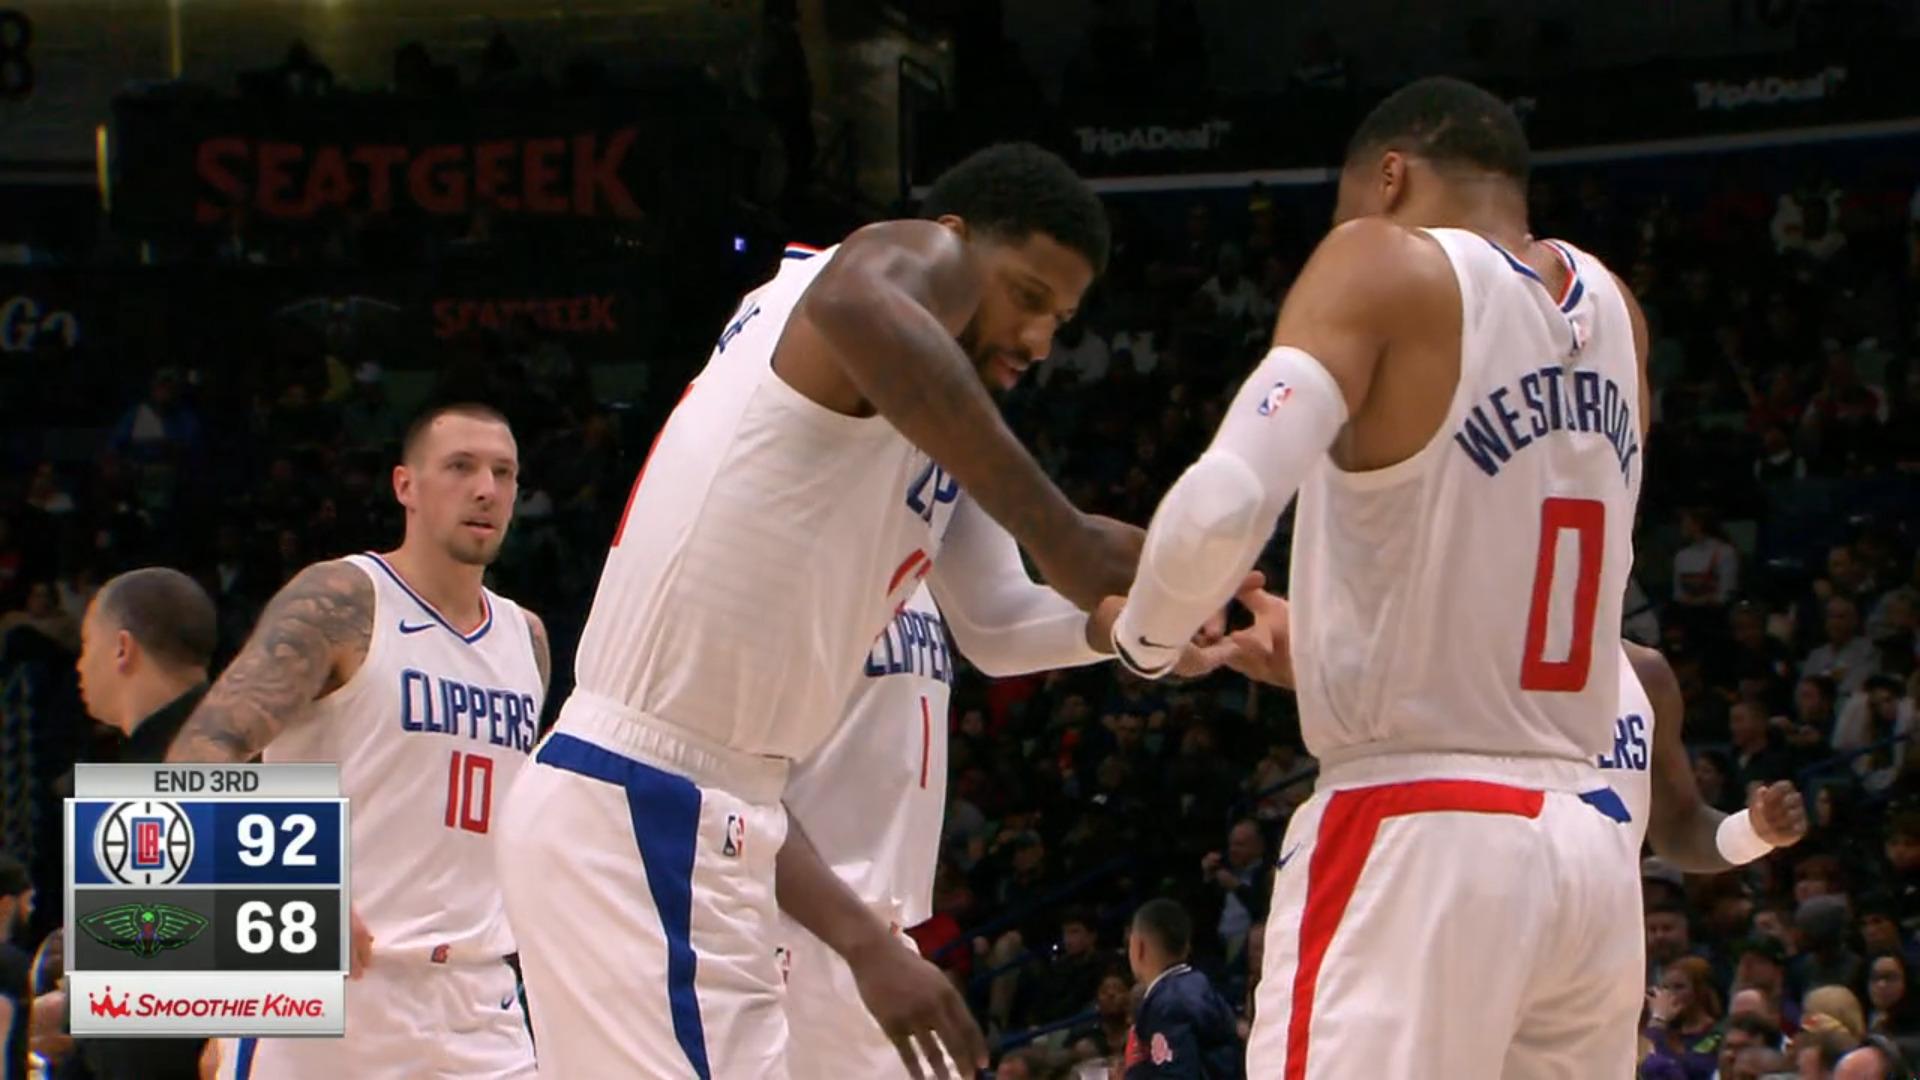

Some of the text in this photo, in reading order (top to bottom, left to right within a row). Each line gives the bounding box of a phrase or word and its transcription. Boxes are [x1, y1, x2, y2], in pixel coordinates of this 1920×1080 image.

[194, 127, 643, 225] SEATGEEK
[1454, 366, 1638, 489] WESTROOK
[1520, 497, 1605, 692] 0
[400, 667, 536, 755] CLIPPERS
[445, 751, 493, 835] 10
